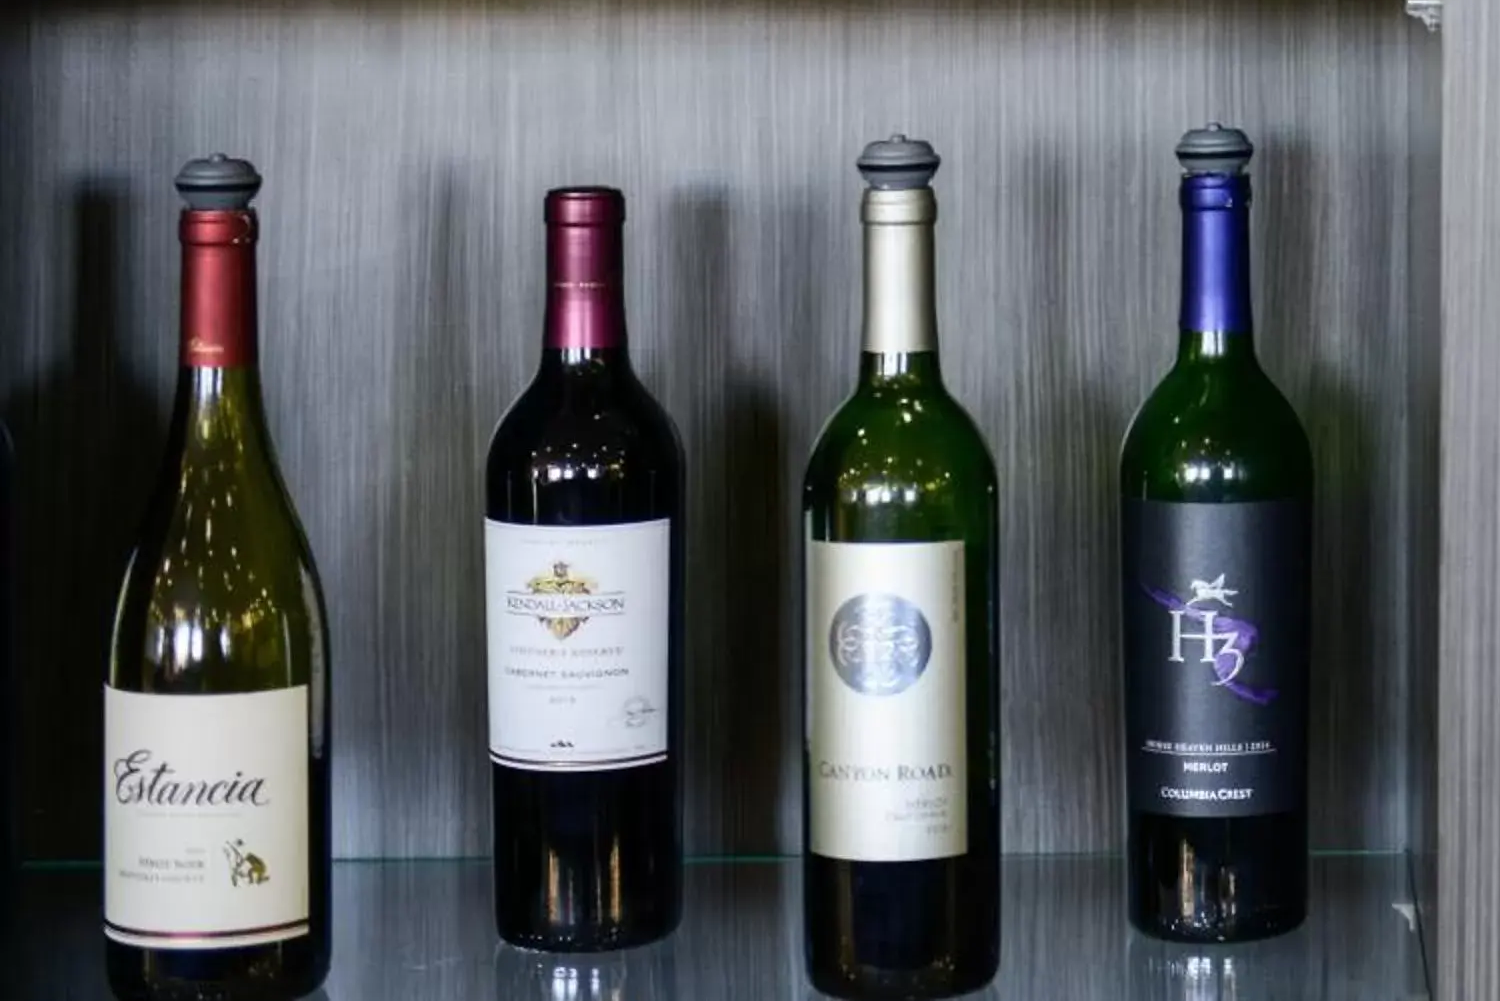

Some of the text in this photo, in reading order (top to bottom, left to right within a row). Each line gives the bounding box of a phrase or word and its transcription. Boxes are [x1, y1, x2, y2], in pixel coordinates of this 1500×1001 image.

[897, 763, 953, 782] ROAD
[1183, 761, 1229, 773] MERLOT
[114, 749, 271, 807] Estancia
